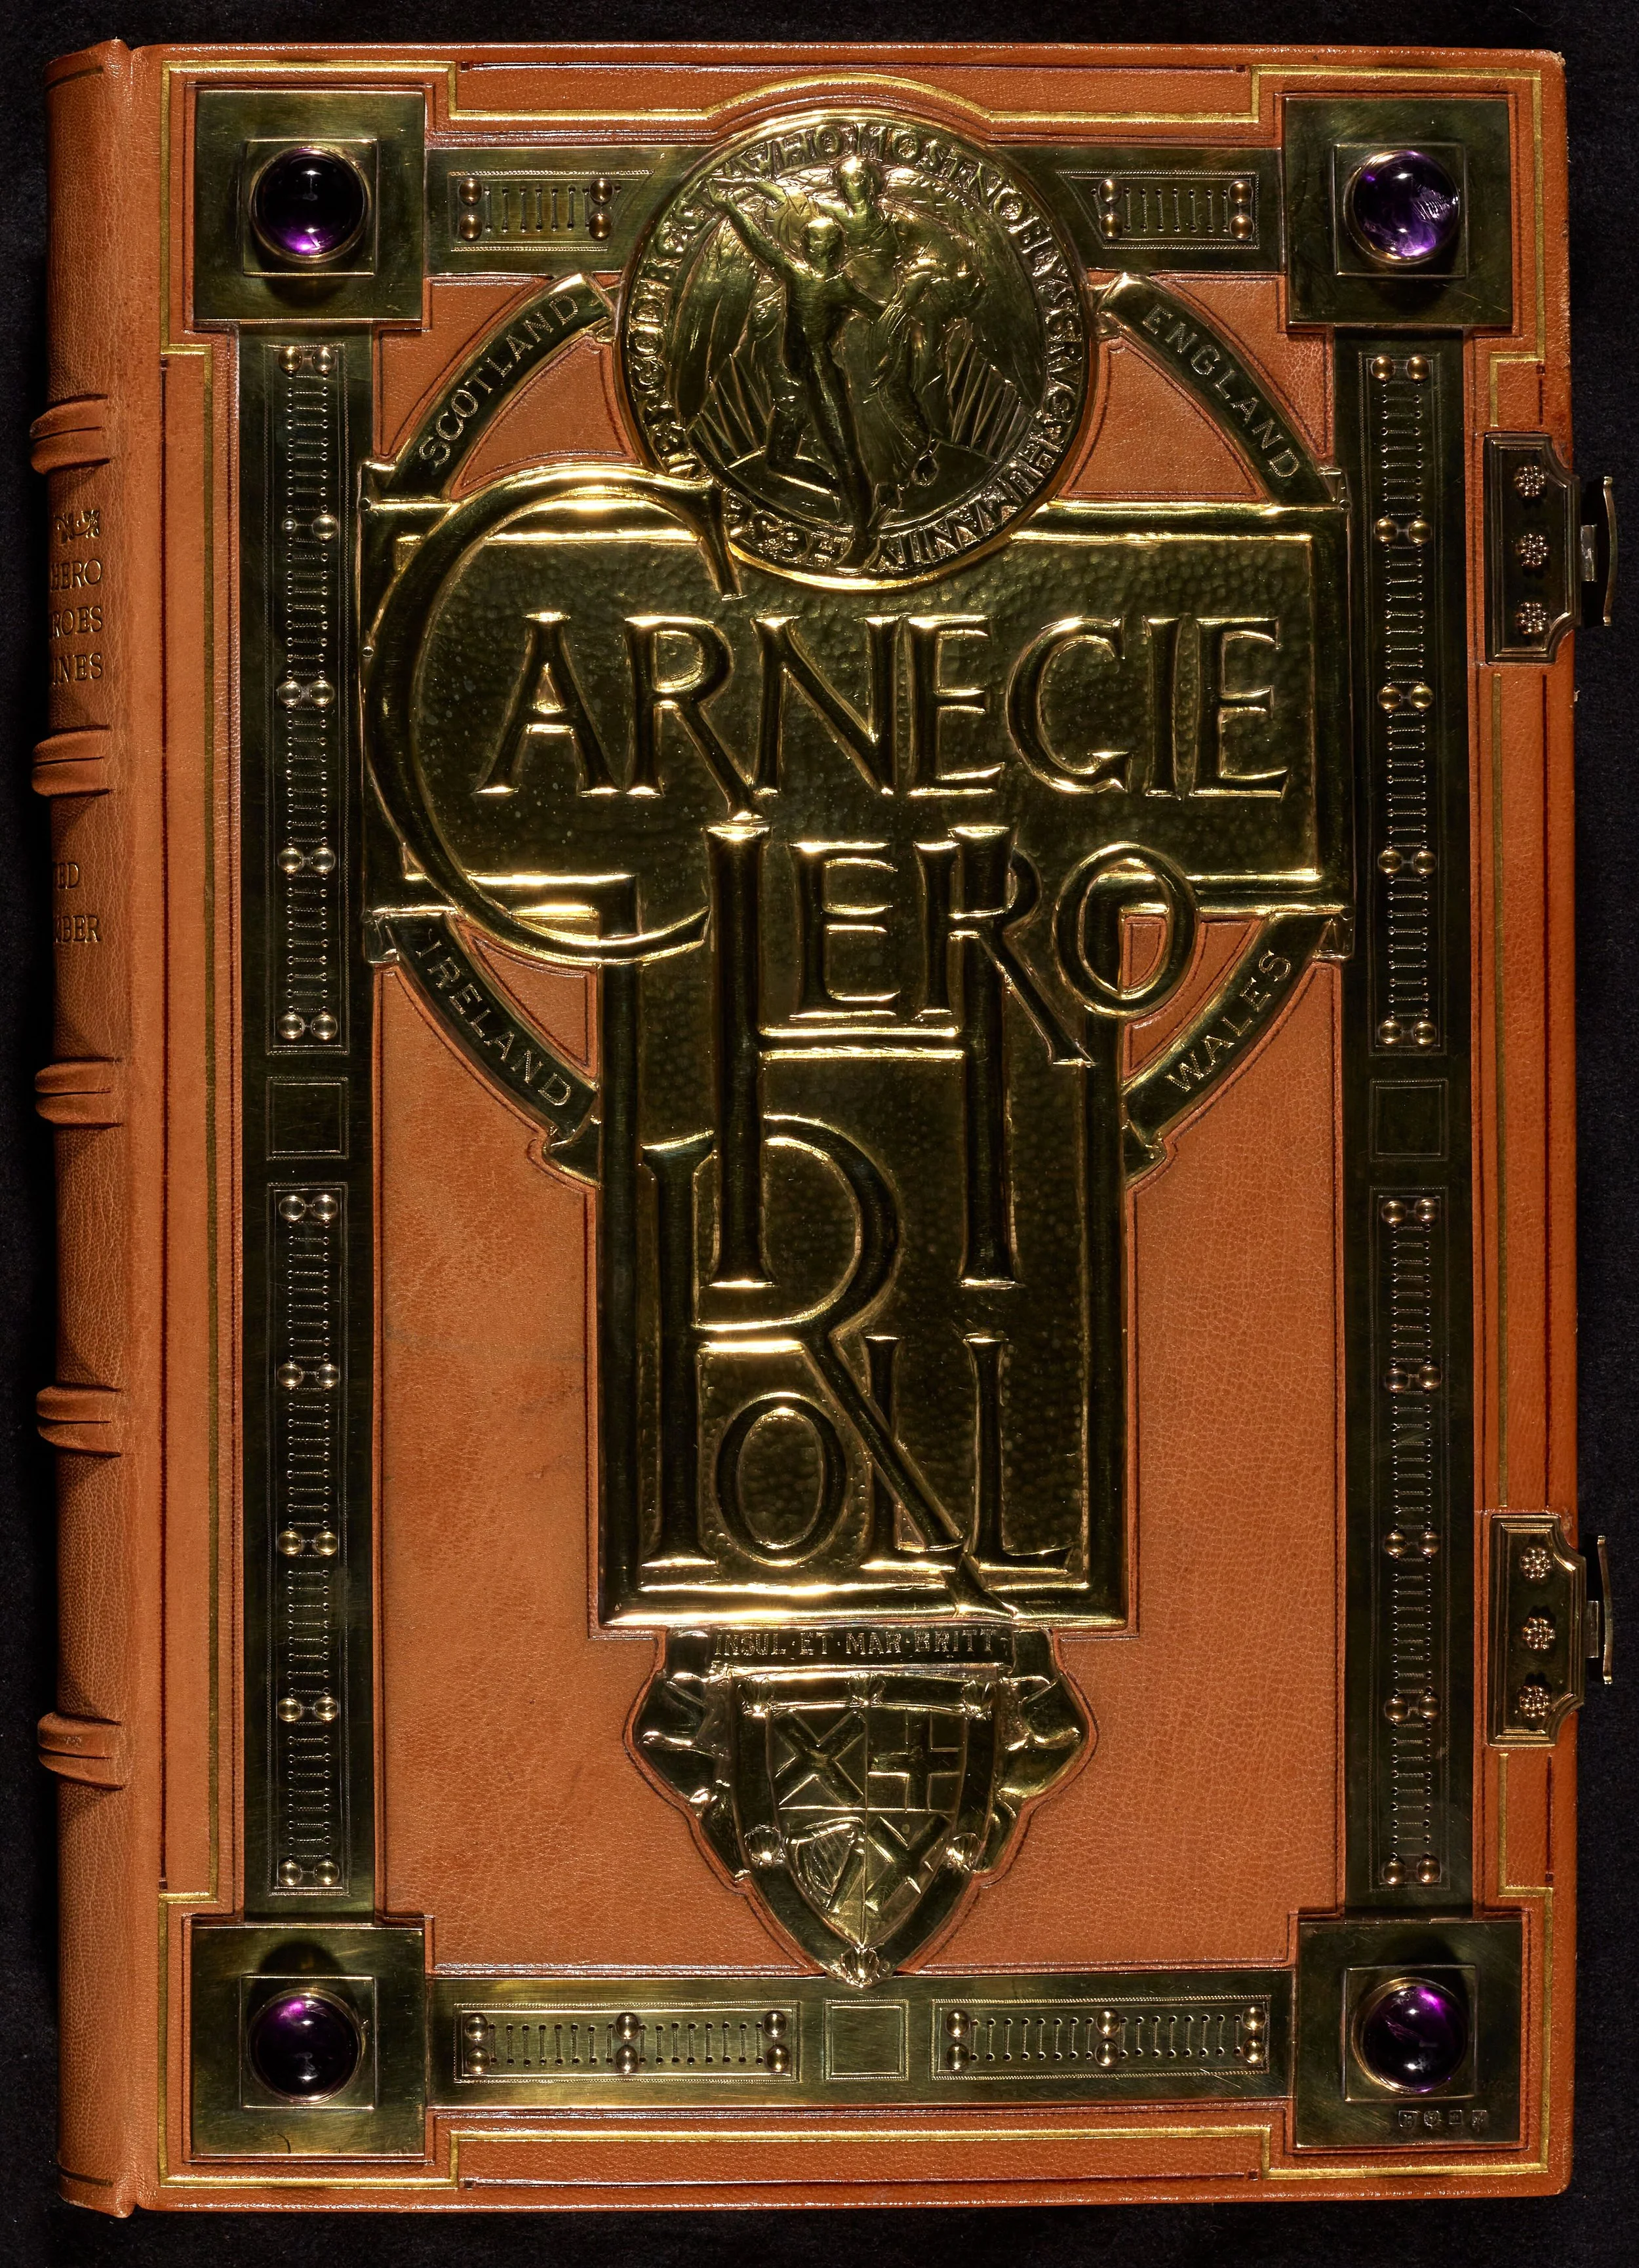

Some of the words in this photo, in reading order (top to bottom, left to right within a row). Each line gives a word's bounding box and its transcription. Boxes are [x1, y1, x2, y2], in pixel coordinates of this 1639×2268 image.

[855, 123, 964, 182] MOST
[964, 160, 1069, 286] NOBLY
[642, 187, 718, 287] BEST
[419, 295, 578, 467] SCOTLAND
[628, 295, 668, 397] GOD
[1035, 283, 1084, 437] SERVES
[1141, 303, 1299, 478] ENGLAND
[642, 398, 789, 555] SEVES
[50, 558, 102, 591] HERO
[365, 463, 1289, 965] CARNEGIE
[52, 862, 79, 889] ED
[416, 940, 570, 1106] IRELAND
[704, 823, 1199, 1289] HERO
[1165, 949, 1292, 1092] WALES
[640, 1113, 1074, 1618] ROLL
